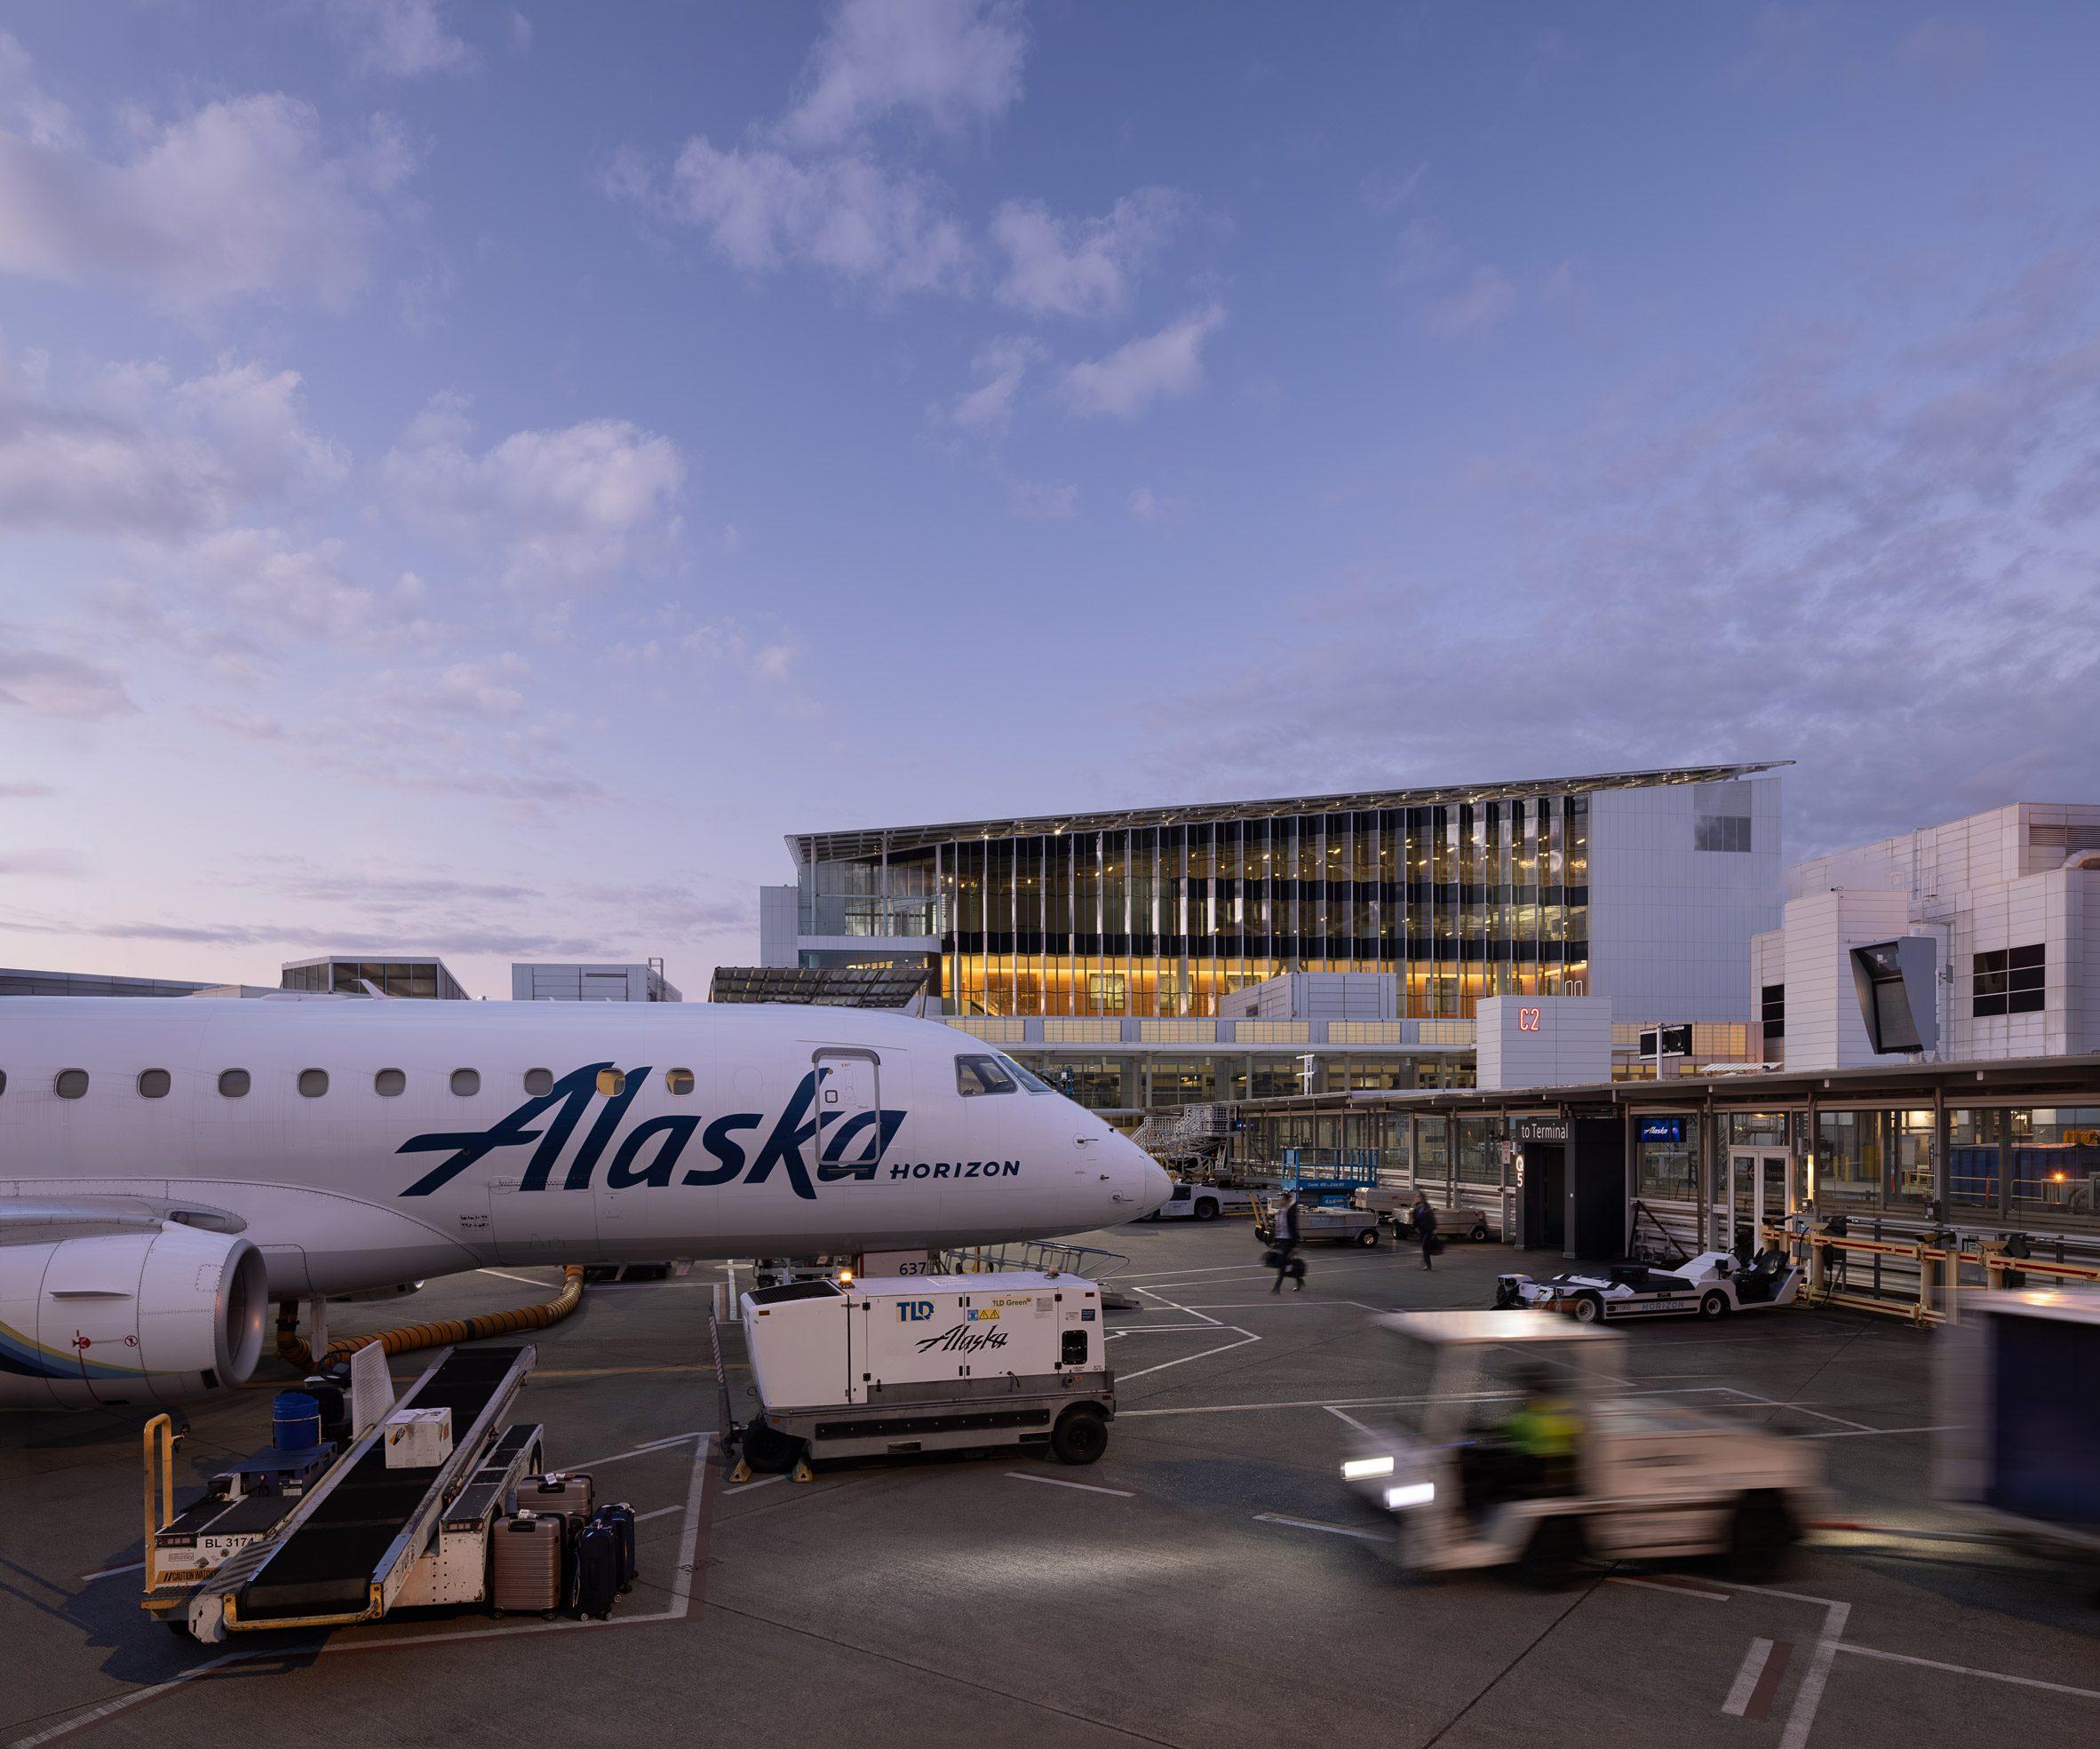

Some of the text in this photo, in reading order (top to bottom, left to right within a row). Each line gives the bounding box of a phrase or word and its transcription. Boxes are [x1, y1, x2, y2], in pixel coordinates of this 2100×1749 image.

[1519, 1007, 1539, 1030] C2
[394, 1061, 907, 1199] Alaska
[1522, 1123, 1569, 1139] to Terminal
[890, 1160, 1020, 1180] HORIZON
[899, 1262, 927, 1276] 637
[897, 1301, 934, 1322] TLD
[1642, 1300, 1684, 1311] HORIZON
[915, 1324, 1008, 1355] Alaska
[205, 1538, 222, 1548] BL
[171, 1570, 195, 1582] CAUTION
